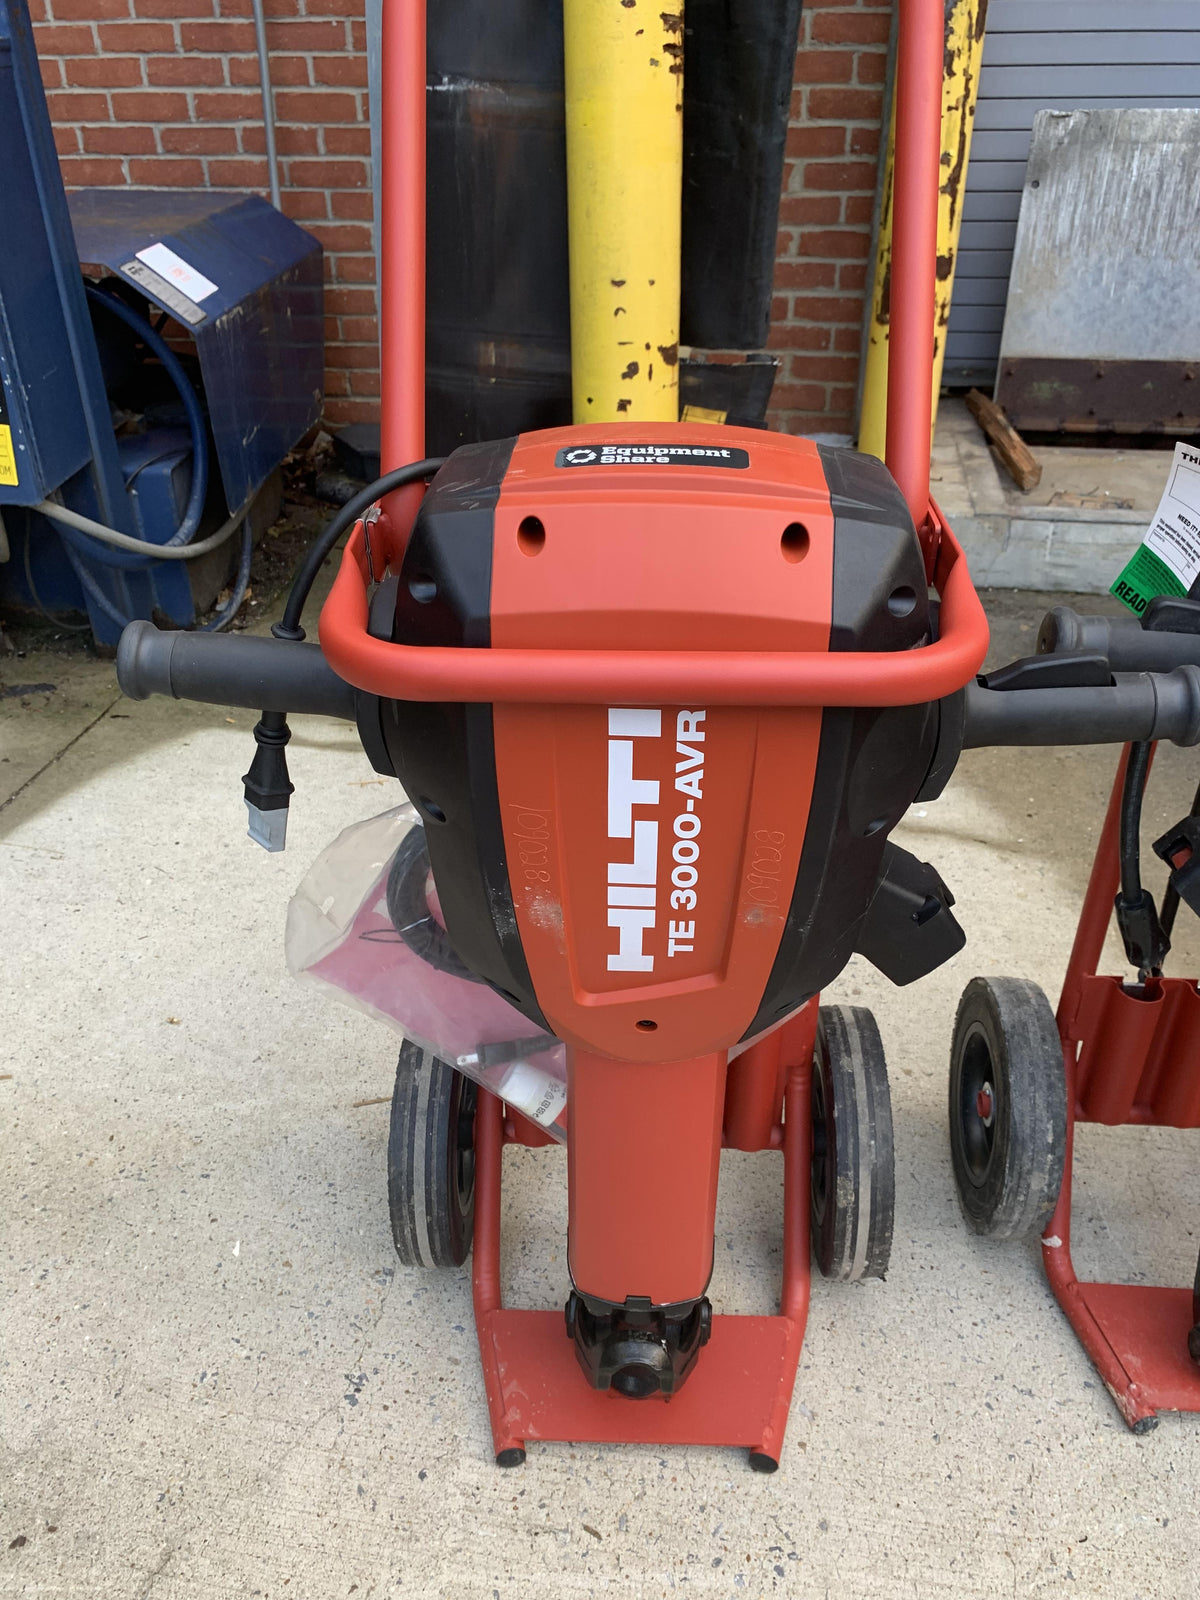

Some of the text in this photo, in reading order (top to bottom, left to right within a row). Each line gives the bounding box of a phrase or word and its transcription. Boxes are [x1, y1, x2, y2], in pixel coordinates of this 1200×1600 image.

[600, 455, 670, 464] Share
[601, 446, 731, 458] Equipment
[1177, 514, 1191, 527] NEED
[1115, 580, 1147, 612] READ
[607, 707, 662, 972] HILTI
[667, 709, 707, 957] TE 3000-AVR
